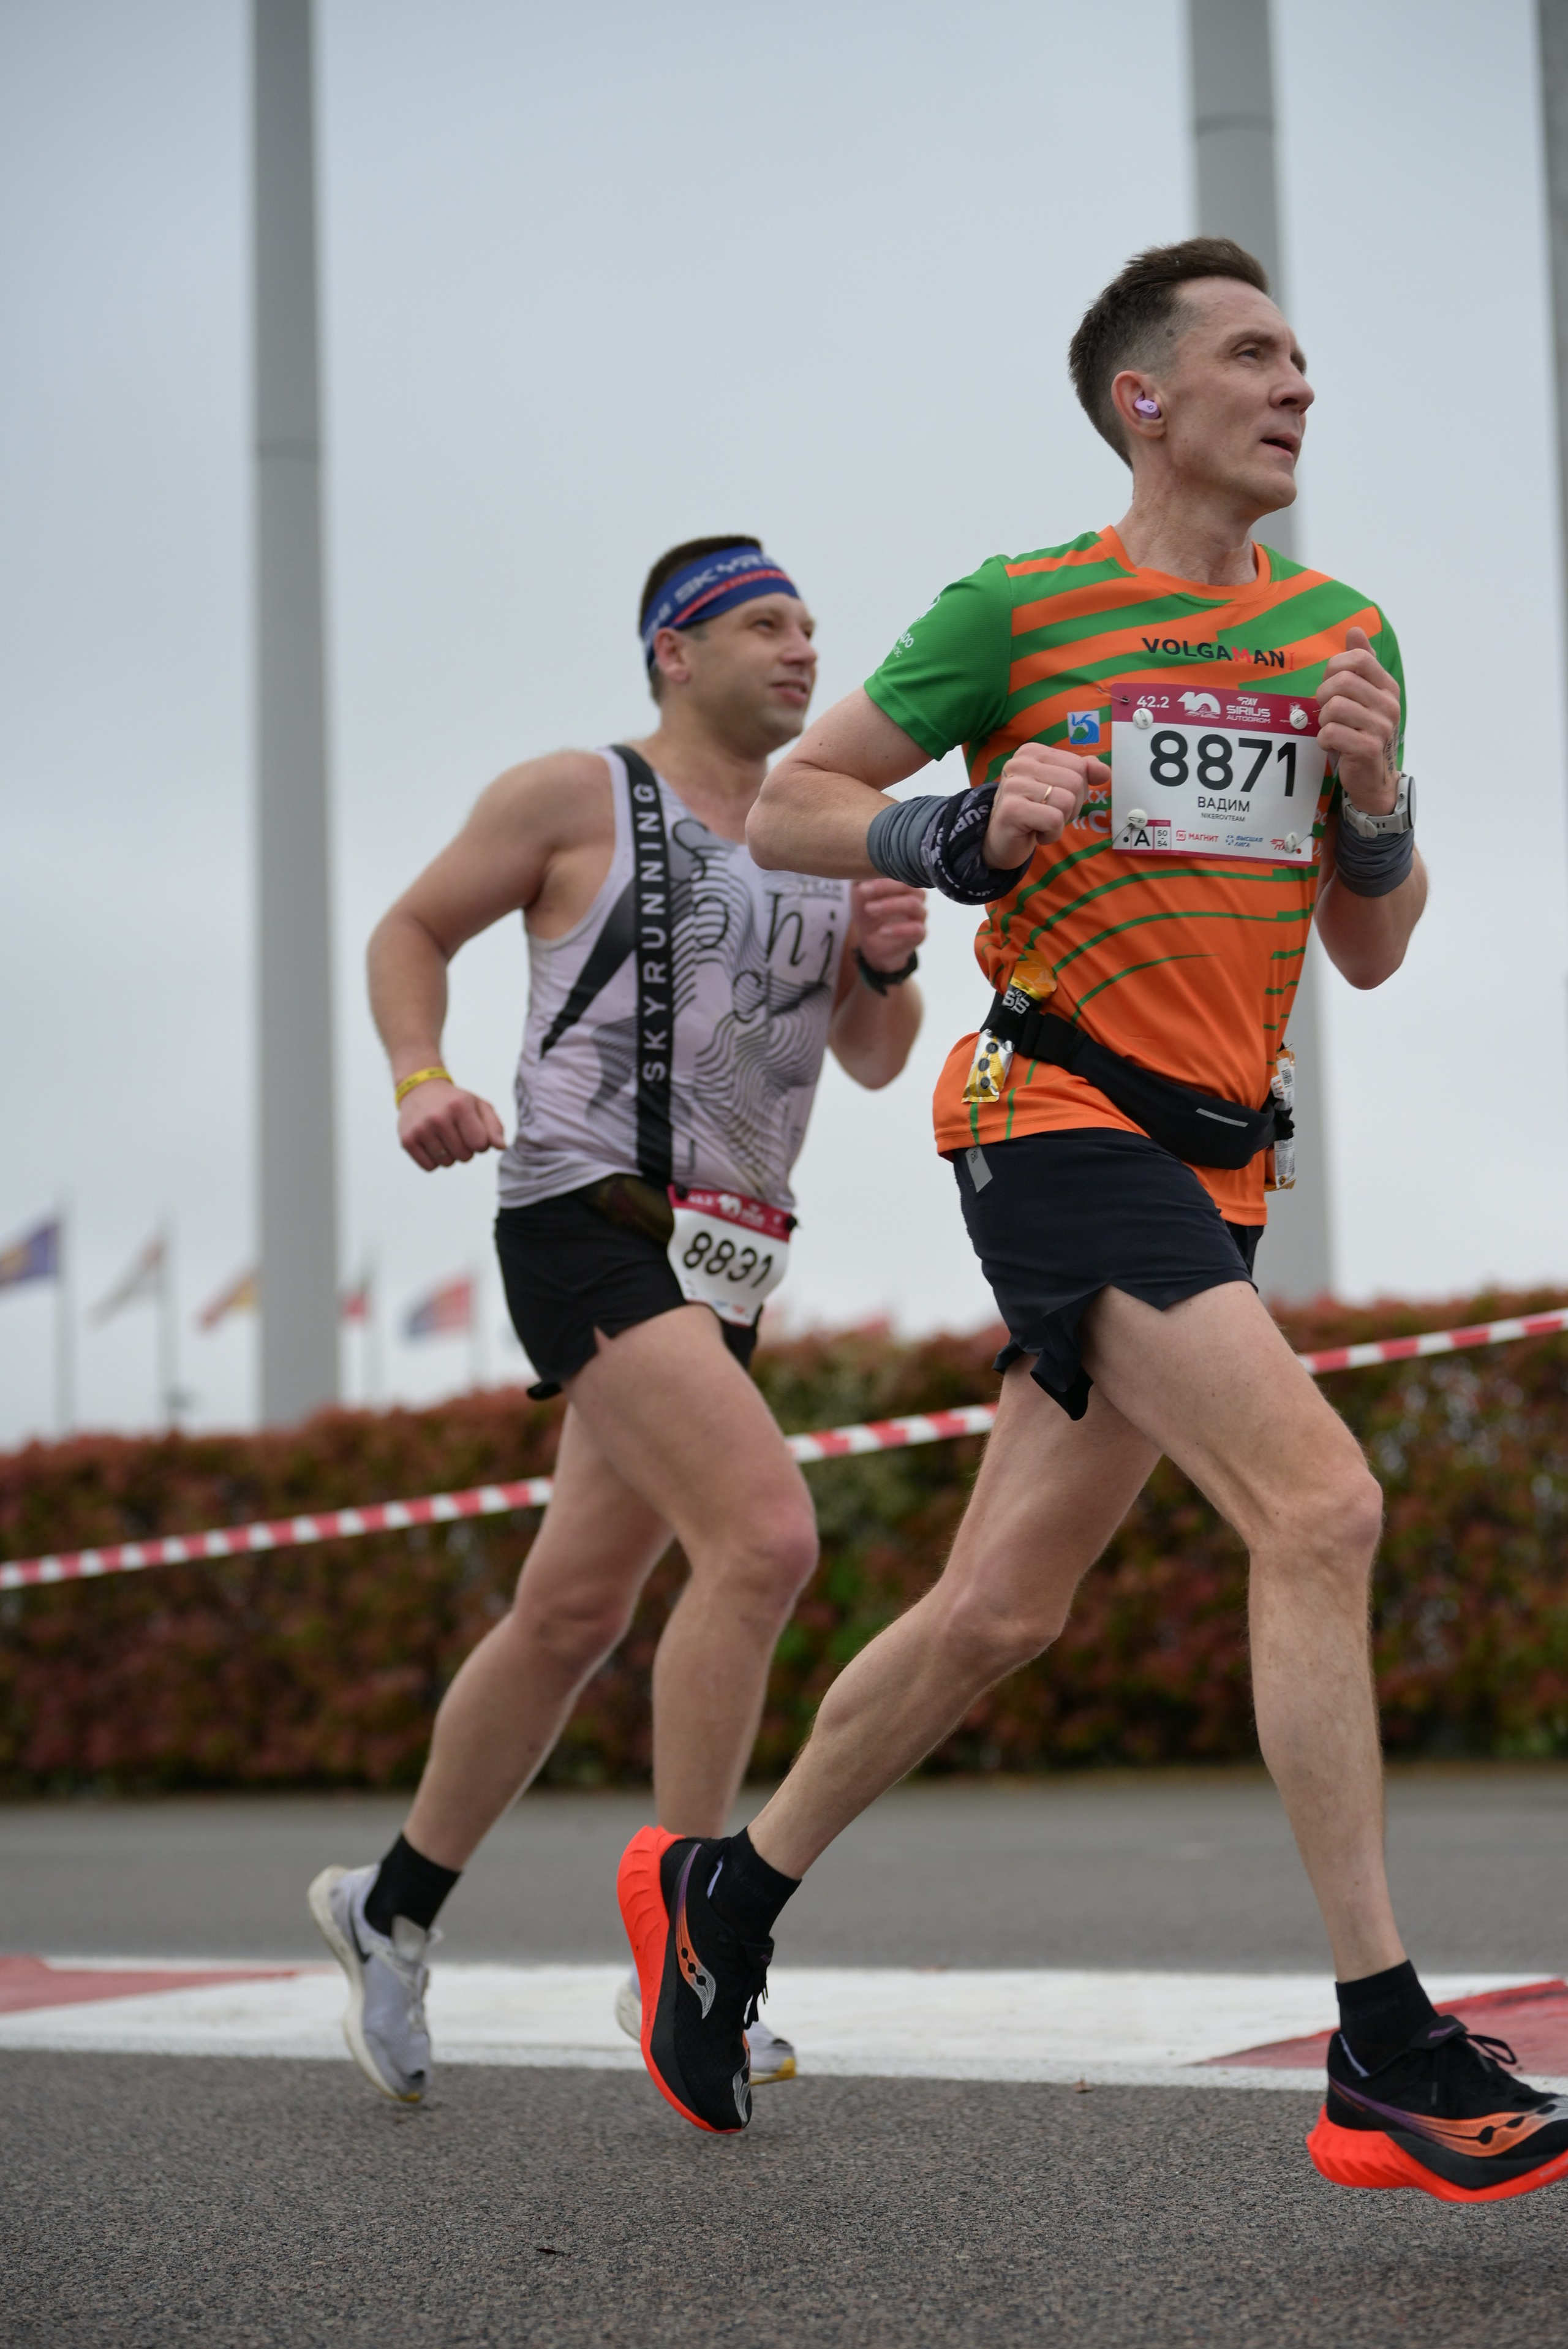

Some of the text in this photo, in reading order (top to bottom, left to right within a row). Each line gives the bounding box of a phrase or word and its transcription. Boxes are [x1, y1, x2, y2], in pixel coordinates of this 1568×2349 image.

[1142, 638, 1284, 668] VOLGAMAN
[1137, 696, 1169, 708] 42.2
[1226, 705, 1271, 717] SIRIUS
[1226, 715, 1271, 724] AUTODROM
[1150, 730, 1297, 797] 8871
[1197, 796, 1250, 812] ВАДИМ
[1188, 833, 1219, 843] МАГНИТ
[634, 784, 668, 1082] SKYRUNNING
[683, 1231, 773, 1288] 8831
